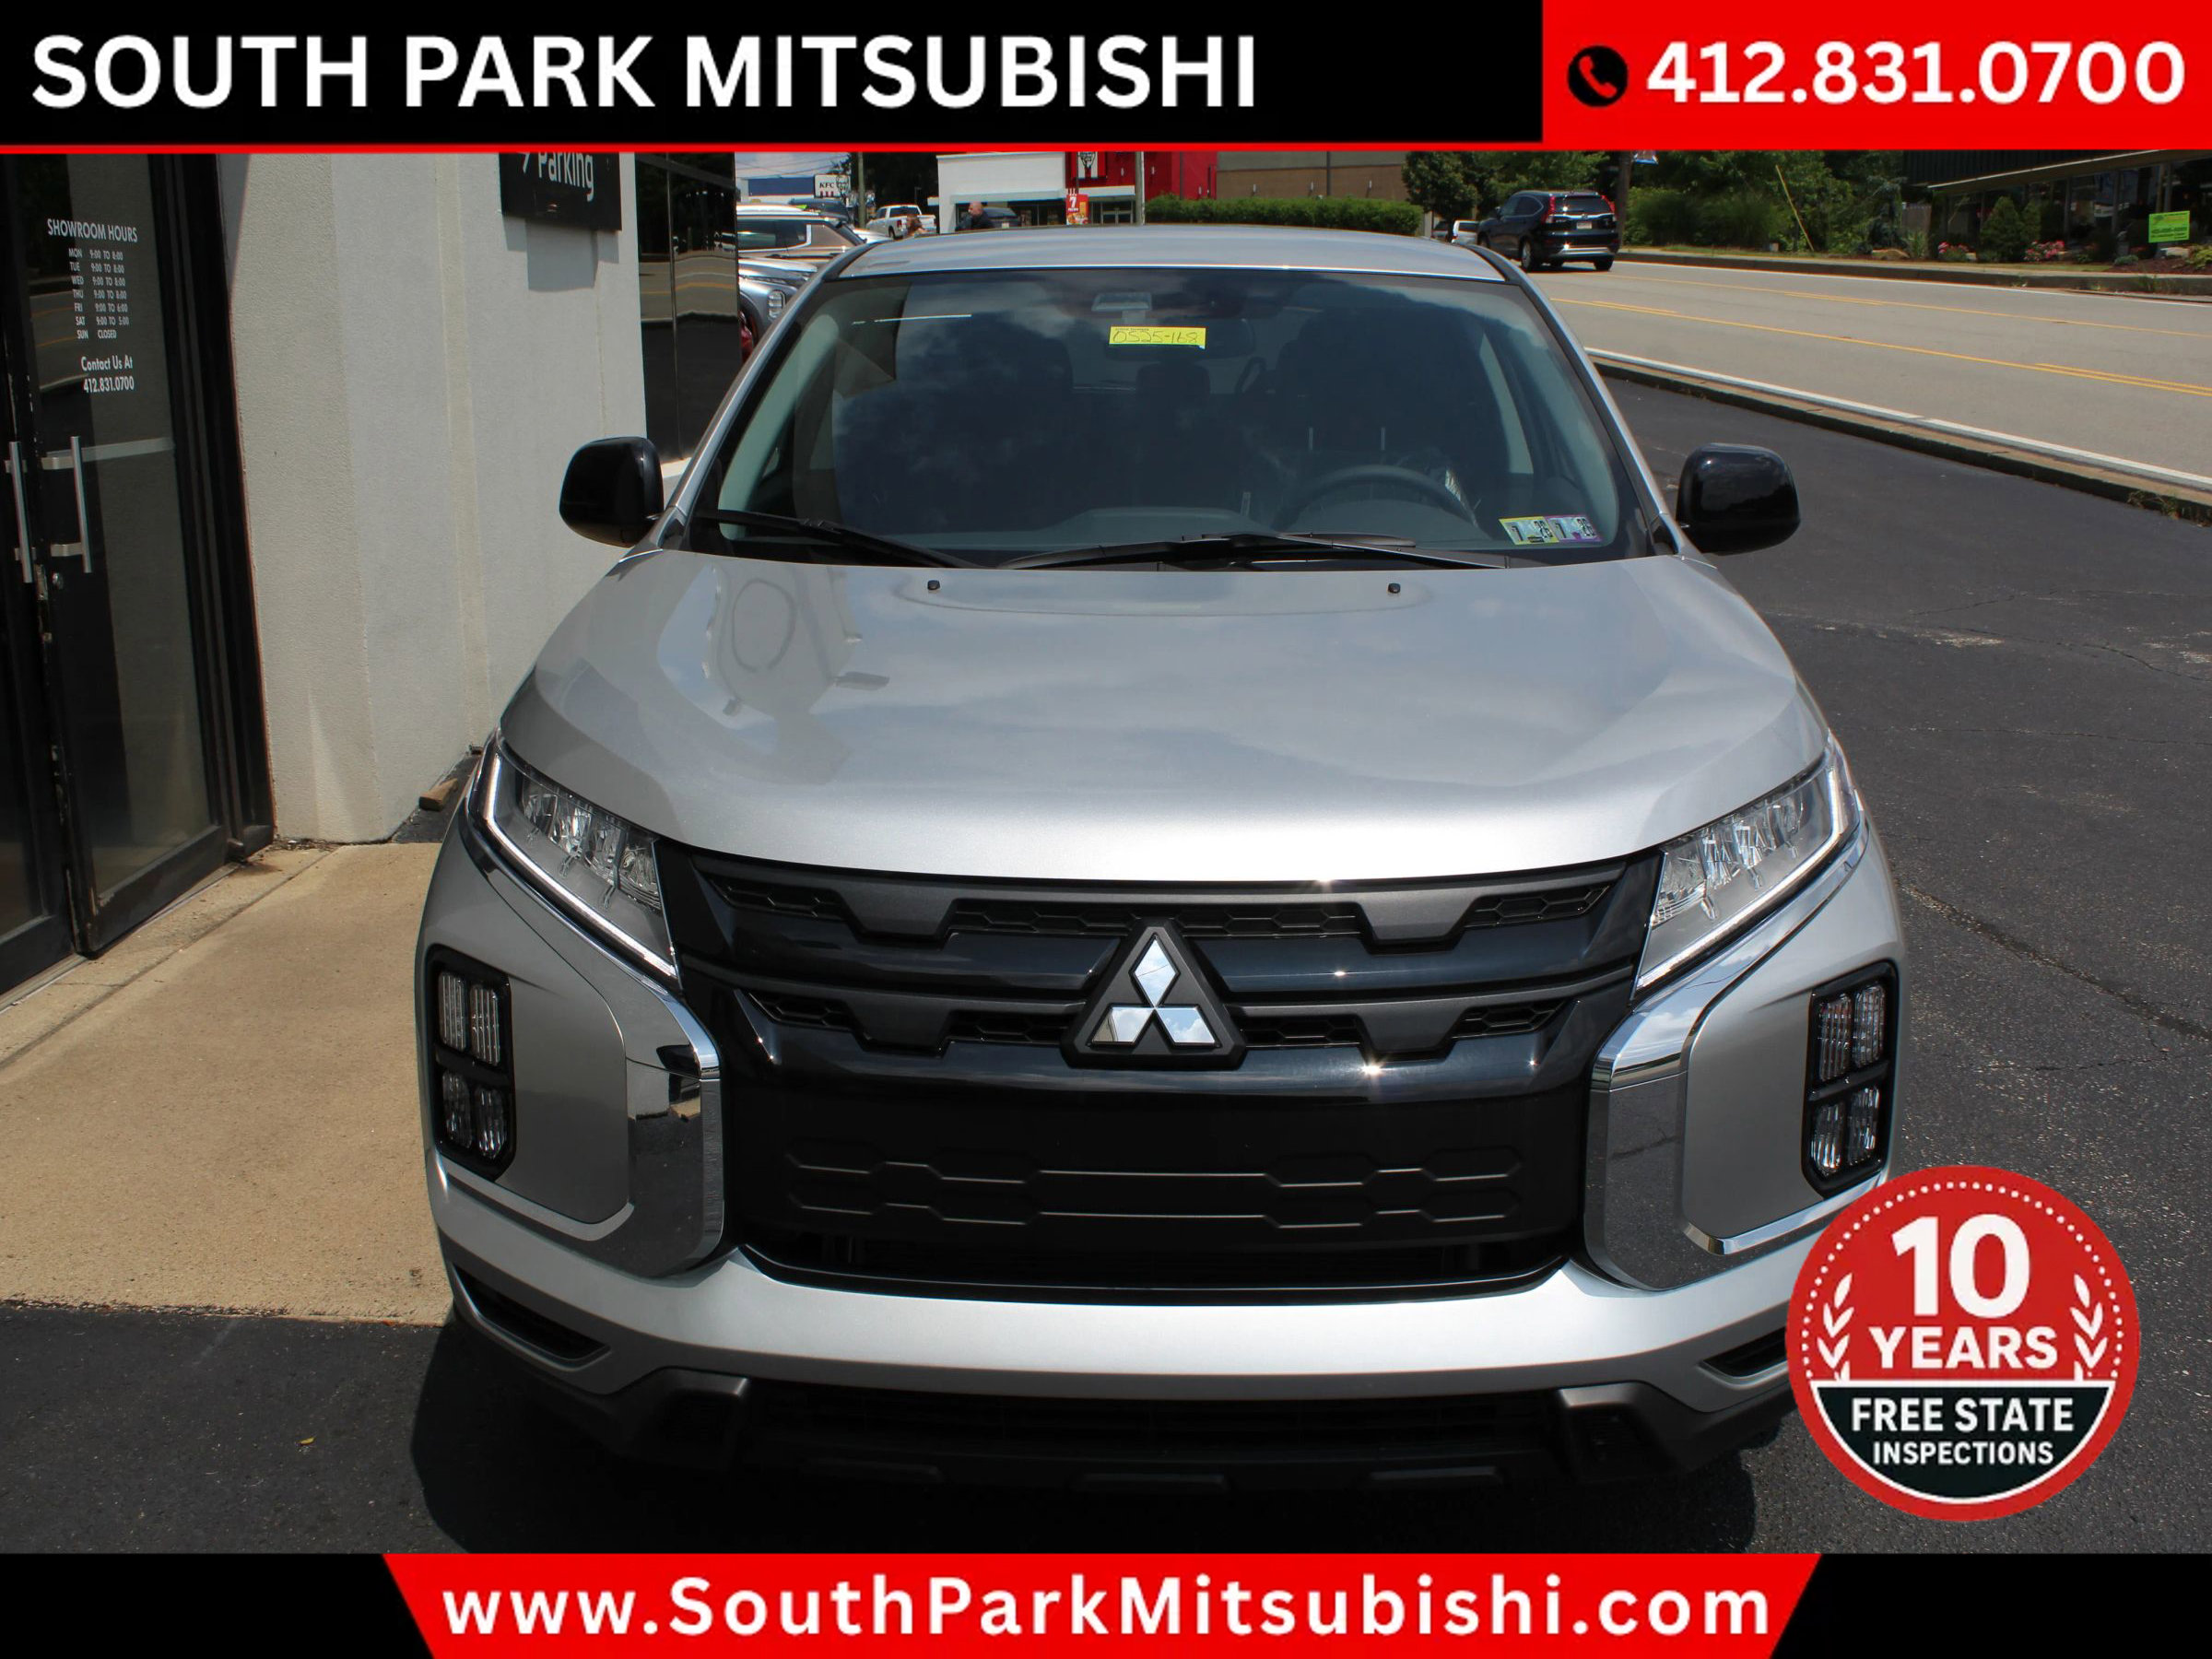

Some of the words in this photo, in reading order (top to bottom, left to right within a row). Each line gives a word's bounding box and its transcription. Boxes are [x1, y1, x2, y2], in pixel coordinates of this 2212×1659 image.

[47, 218, 107, 241] SHOWROOM
[109, 225, 137, 242] HOURS
[68, 248, 82, 258] MON
[89, 249, 101, 260] 9:00
[103, 251, 111, 260] TO
[69, 262, 80, 271] TUE
[90, 263, 102, 273] 9:00
[103, 264, 112, 273] TO
[71, 276, 84, 285] WED
[92, 276, 104, 286] 9:00
[105, 277, 112, 287] TO
[73, 289, 84, 299] THU
[93, 289, 105, 300] 9:00
[106, 290, 114, 300] TO
[74, 302, 83, 312] FRI
[95, 303, 106, 312] 9:00
[108, 303, 115, 312] TO
[76, 316, 86, 325] SAT
[96, 316, 107, 325] 9:00
[109, 316, 116, 325] TO
[76, 330, 88, 339] SUN
[98, 330, 117, 339] CLOSED
[81, 356, 111, 371] Contact
[112, 355, 123, 370] Us
[124, 354, 133, 370] At
[84, 375, 135, 394] 412.831.0700
